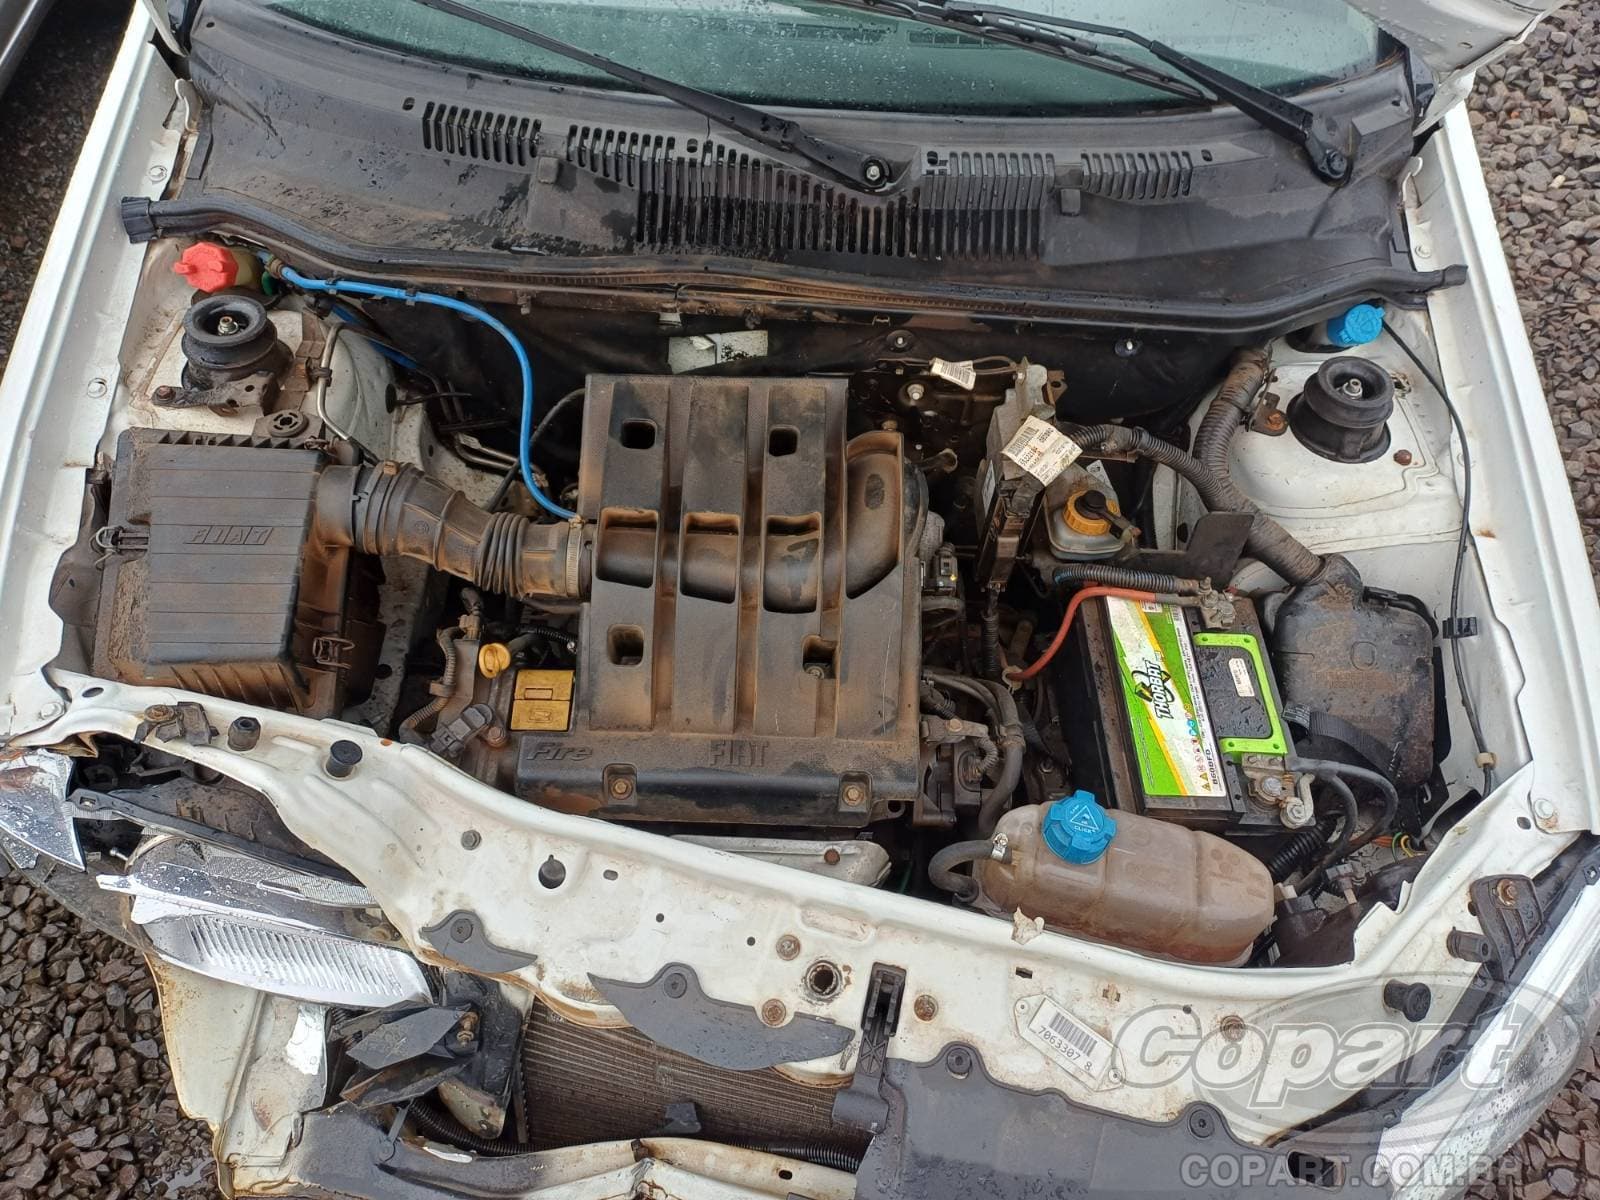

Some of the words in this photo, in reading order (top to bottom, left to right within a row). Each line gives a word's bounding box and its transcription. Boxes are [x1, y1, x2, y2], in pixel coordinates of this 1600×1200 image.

[183, 524, 273, 546] FIAT
[1144, 659, 1174, 719] THORBAT
[526, 741, 593, 762] Fire
[709, 739, 769, 767] FIAT
[1038, 1025, 1081, 1061] 7063307
[1084, 1061, 1093, 1071] 8
